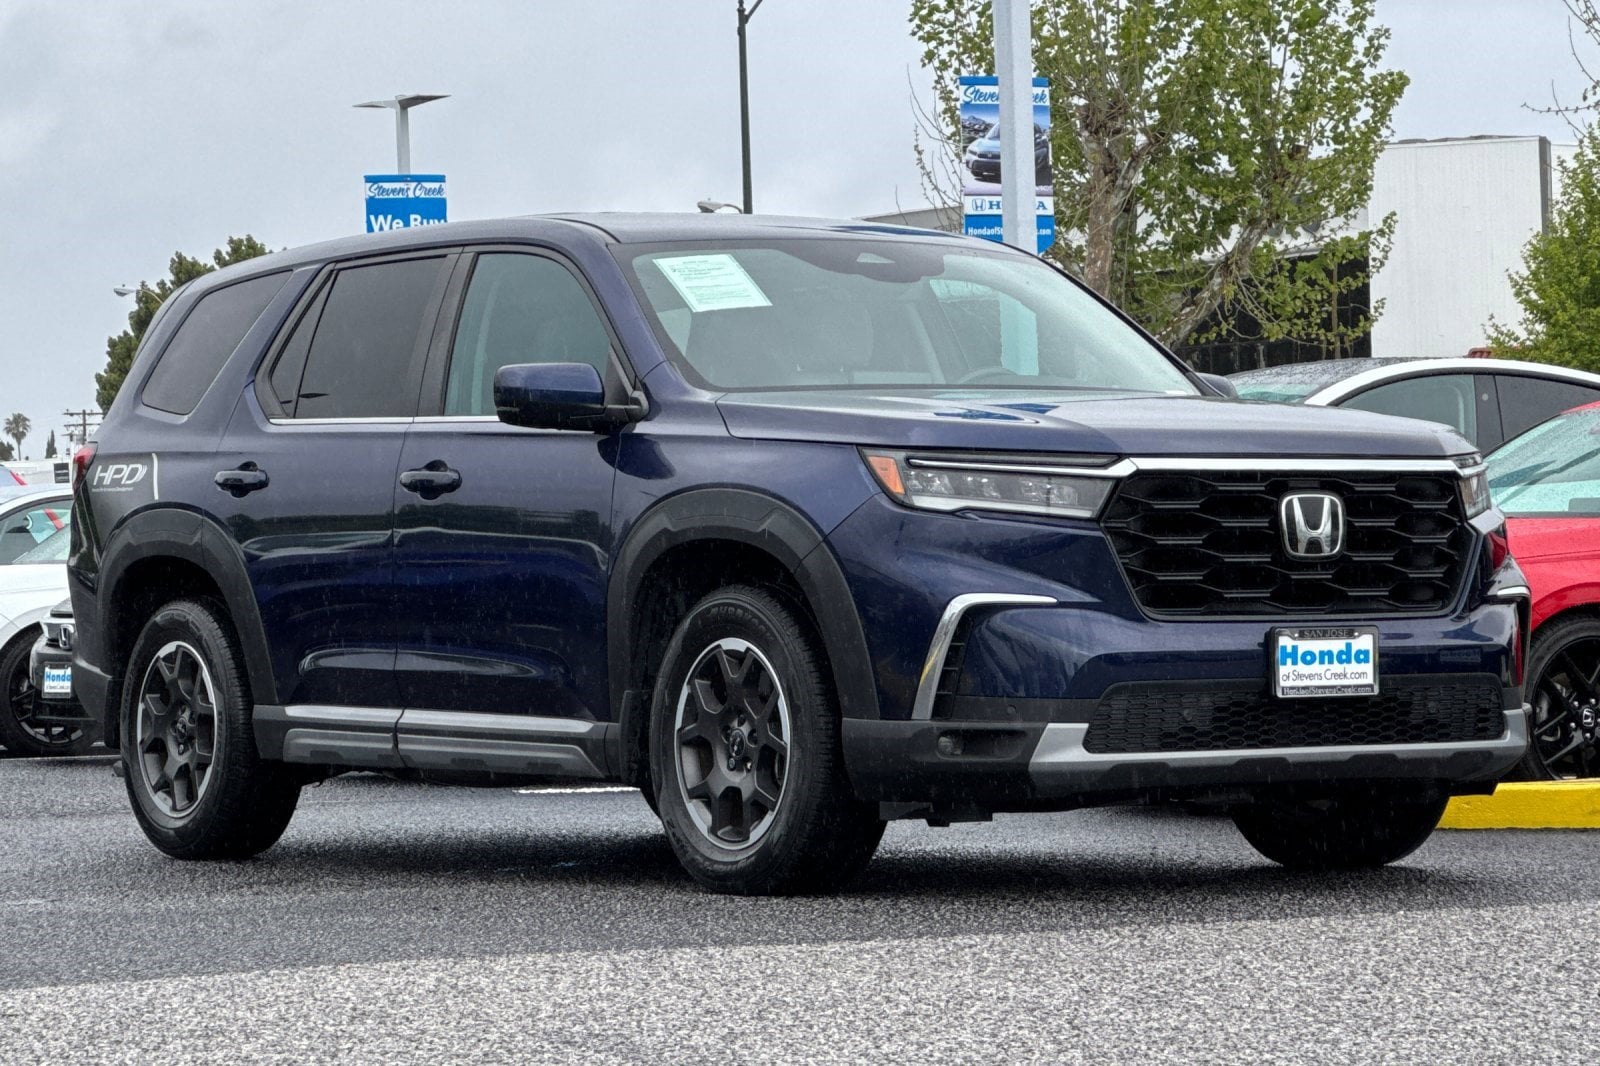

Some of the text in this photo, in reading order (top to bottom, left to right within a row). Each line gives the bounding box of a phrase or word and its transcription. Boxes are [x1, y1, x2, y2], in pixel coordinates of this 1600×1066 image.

[963, 85, 999, 104] Steve
[368, 182, 444, 198] Stevens Creek
[369, 214, 404, 232] We
[93, 463, 147, 486] HPD
[1303, 629, 1350, 638] SAN JOSE
[1279, 642, 1370, 667] Honda
[1281, 666, 1368, 682] of Stevens Creek.com
